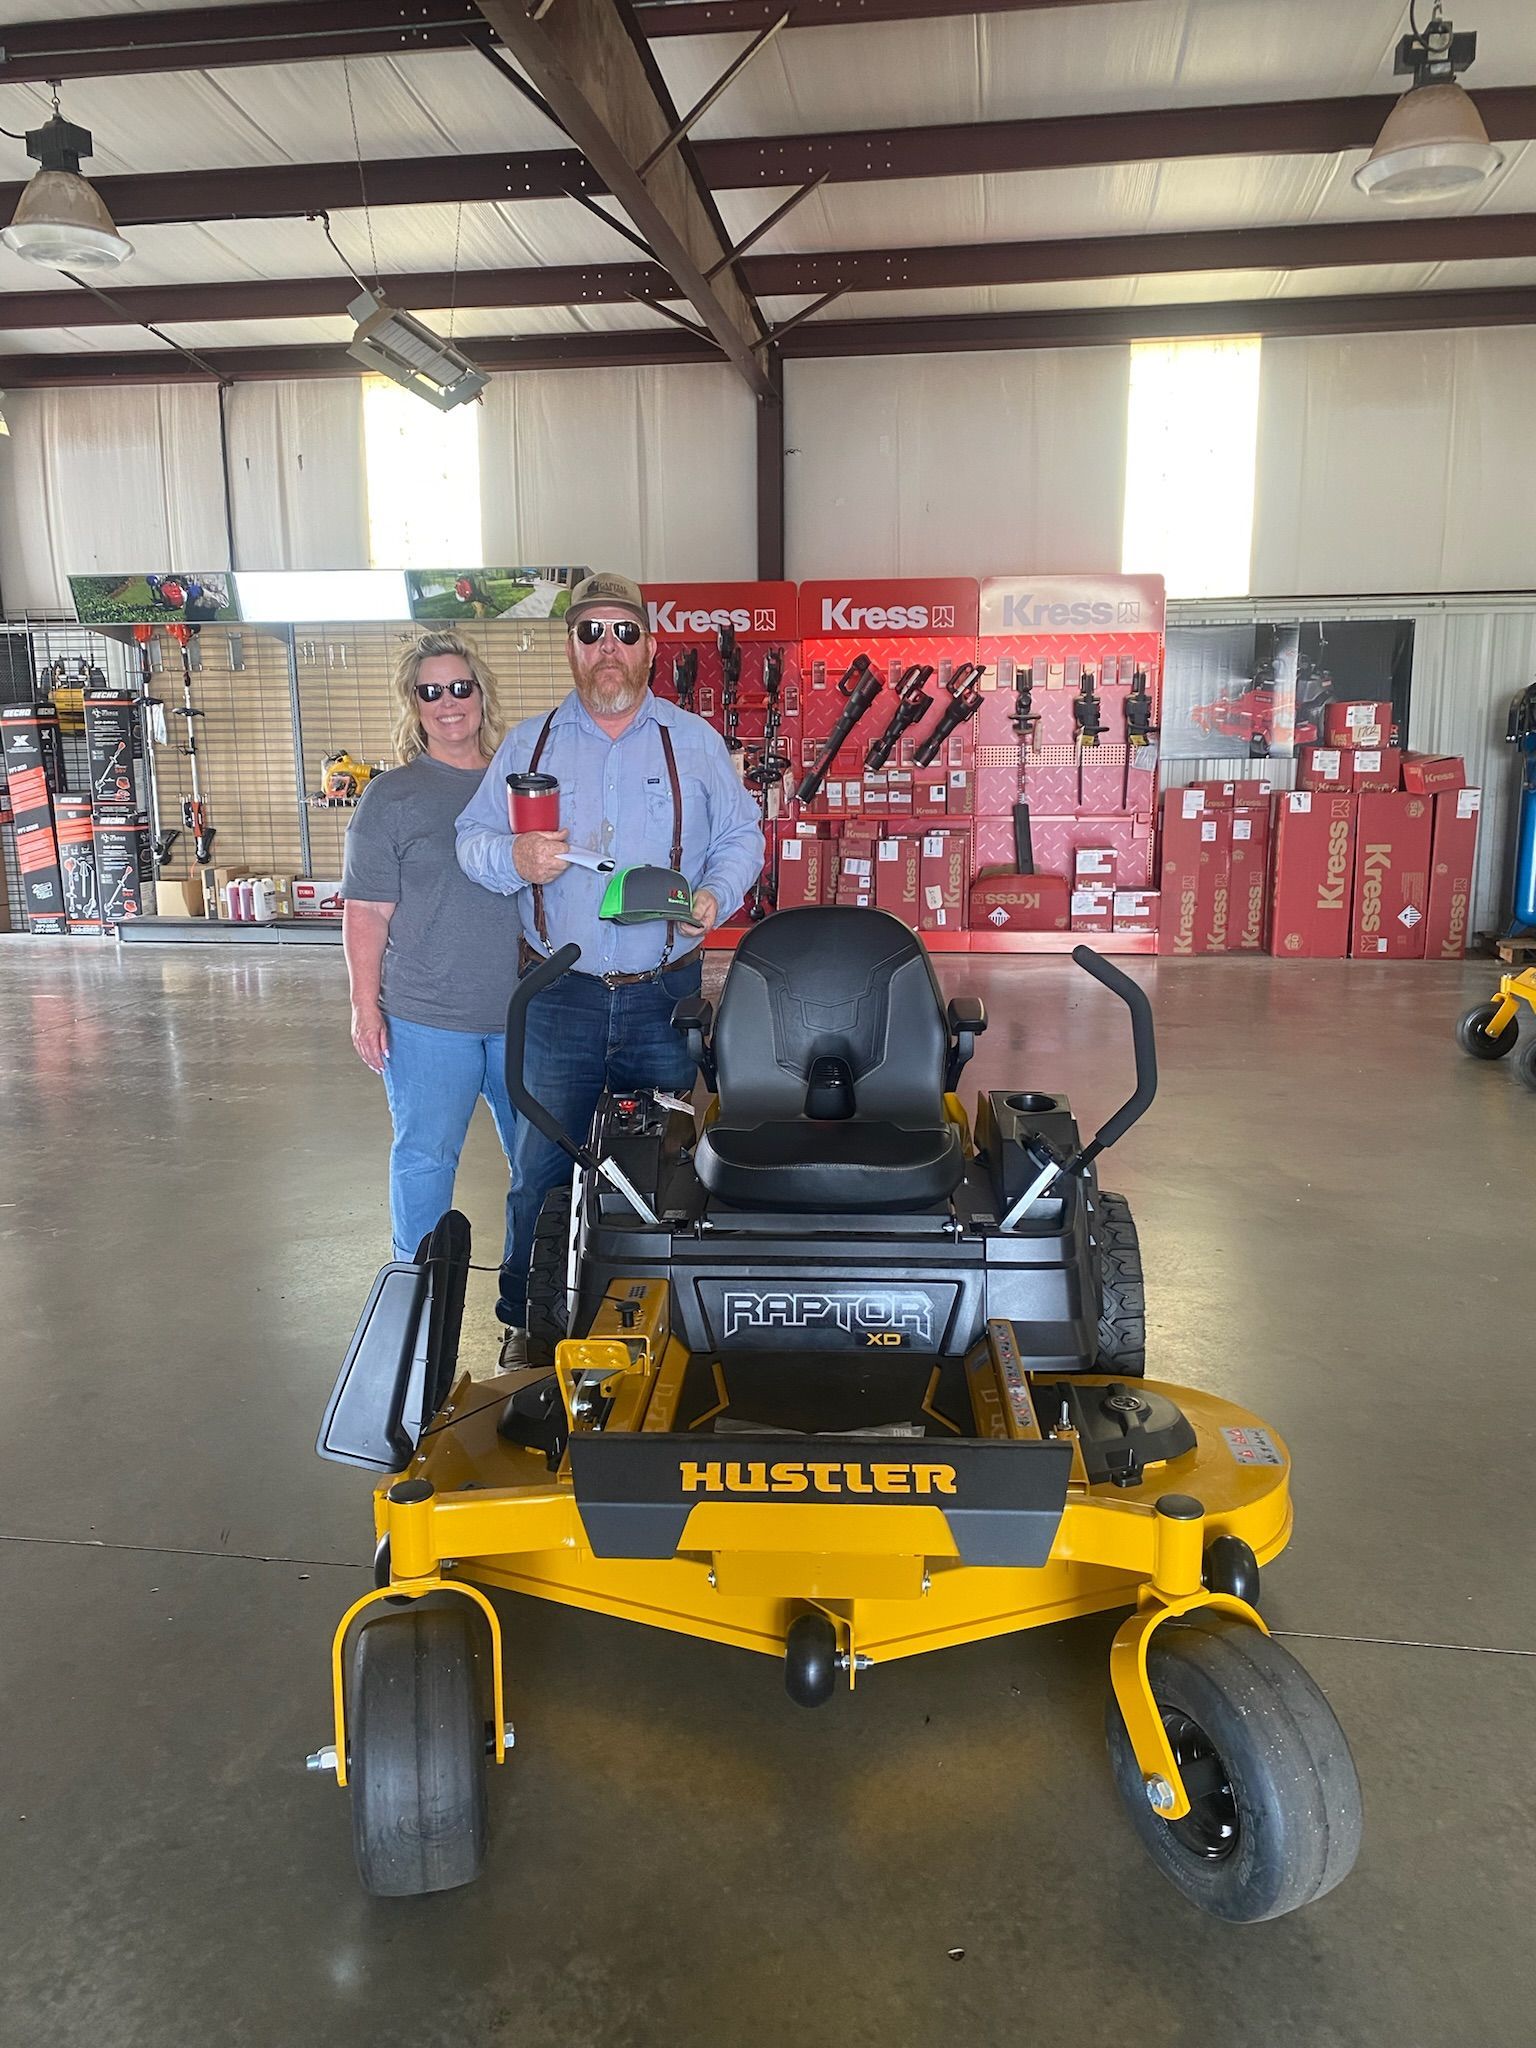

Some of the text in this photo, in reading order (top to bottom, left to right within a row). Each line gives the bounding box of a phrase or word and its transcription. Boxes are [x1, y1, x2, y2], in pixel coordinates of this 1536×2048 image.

[648, 601, 751, 633] Kress
[821, 598, 928, 631] Kress
[1003, 595, 1113, 627] Kress
[9, 708, 31, 717] ECHO
[1425, 773, 1454, 783] Kress
[847, 830, 870, 838] Kress
[804, 858, 818, 901] Kress
[827, 856, 840, 899] Kress
[903, 858, 916, 903] Kress
[944, 853, 960, 908] Kress
[1317, 820, 1349, 909] Kress
[985, 892, 1040, 909] Kress
[1361, 844, 1392, 932] Kress
[1174, 890, 1195, 953] Kress
[1207, 888, 1228, 950] Kress
[1241, 886, 1262, 947] Kress
[1441, 893, 1466, 957] Kress
[724, 1292, 936, 1343] RAPTOR
[866, 1332, 902, 1346] XD
[679, 1461, 957, 1494] HUSTLER
